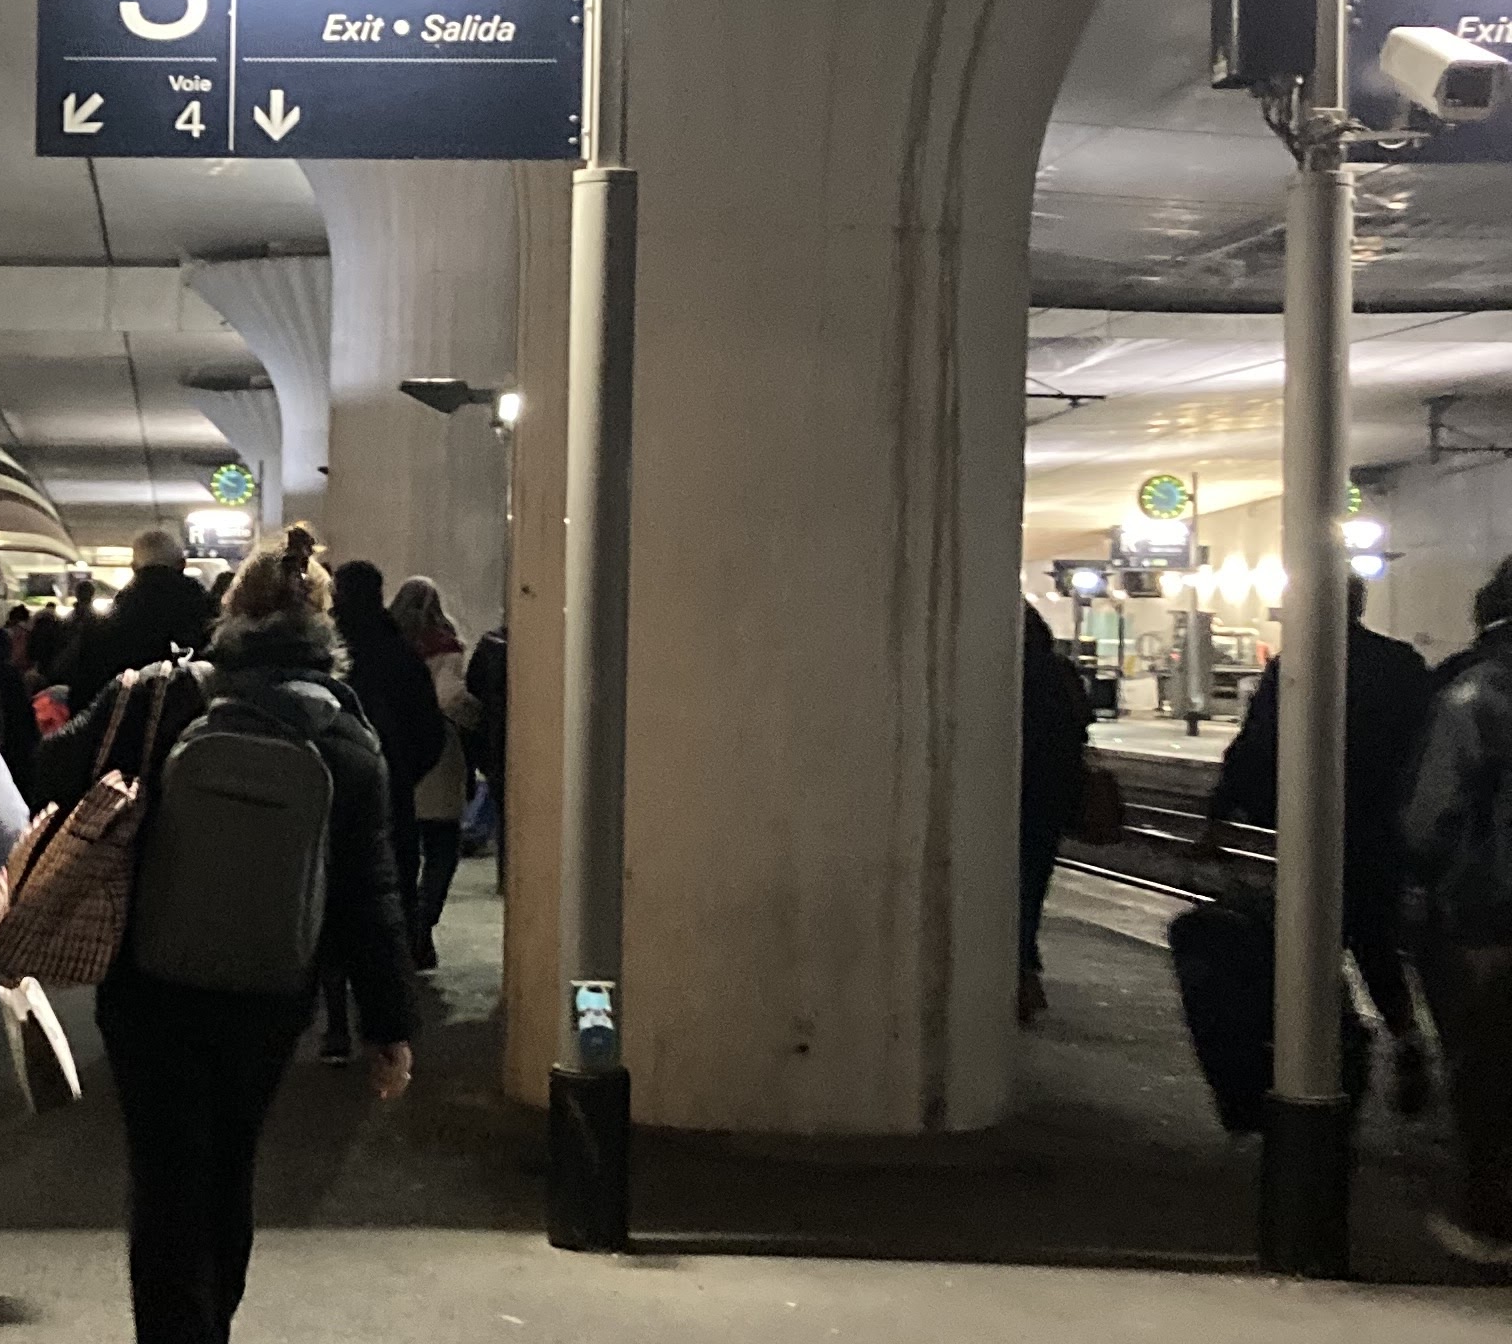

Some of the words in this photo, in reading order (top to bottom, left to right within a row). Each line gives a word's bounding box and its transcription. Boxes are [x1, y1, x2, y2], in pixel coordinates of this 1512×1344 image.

[322, 13, 385, 42] Exit
[420, 13, 516, 42] Salida
[168, 75, 213, 92] Voie
[174, 100, 206, 138] 4
